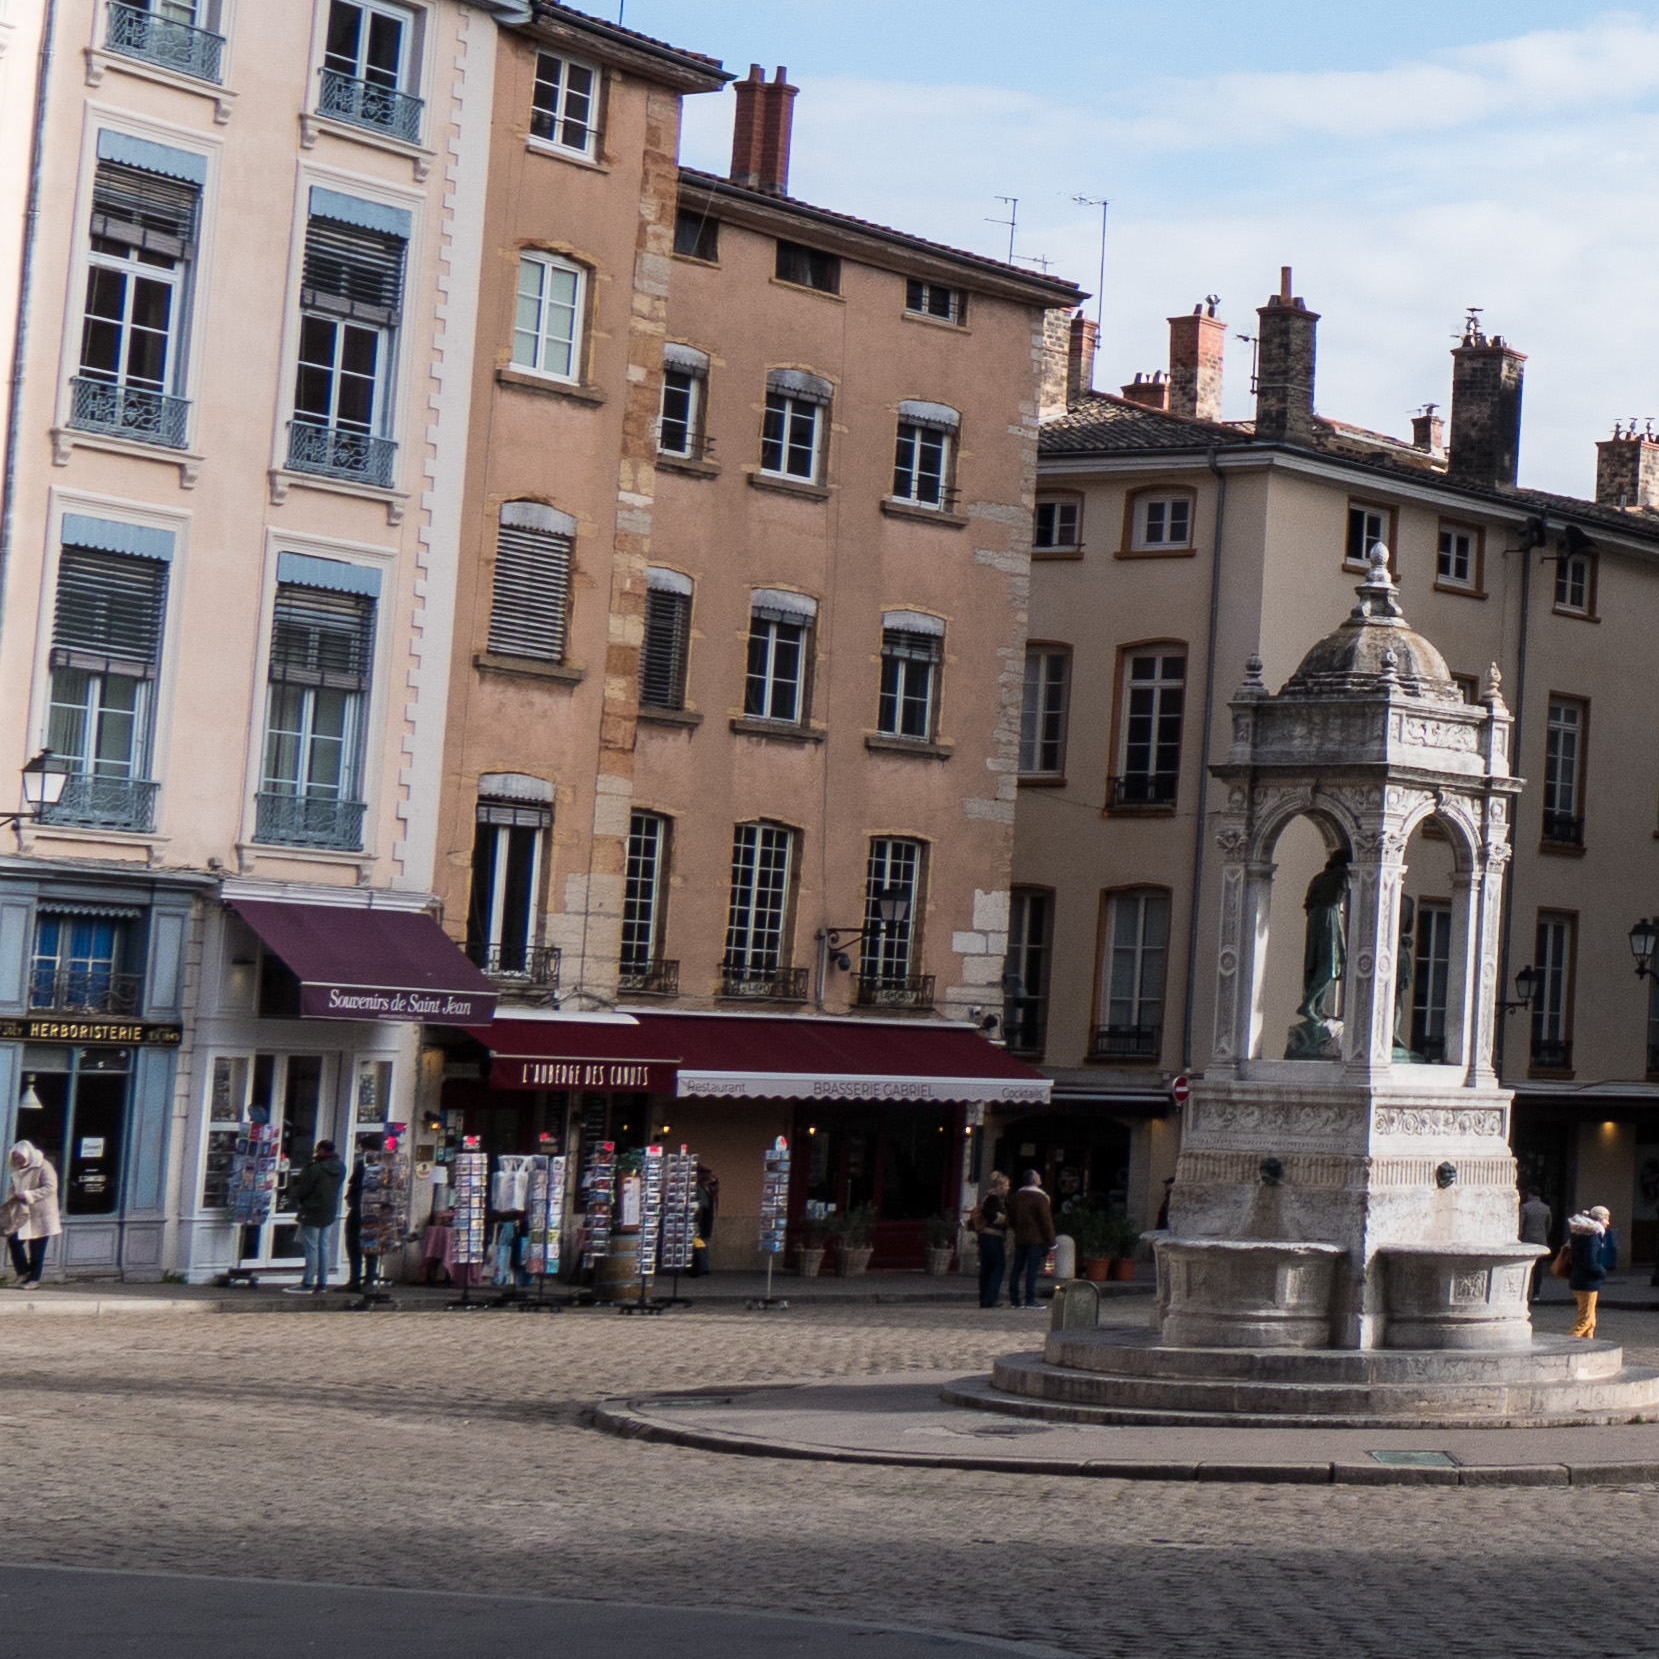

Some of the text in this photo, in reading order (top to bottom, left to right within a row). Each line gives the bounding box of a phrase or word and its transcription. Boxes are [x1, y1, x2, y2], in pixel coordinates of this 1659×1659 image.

[329, 989, 471, 1015] Souvenirs de Saint Jean
[30, 1023, 143, 1040] HERBORISTERIE
[522, 1063, 649, 1086] L'AUBERGE DES CANUTS
[687, 1079, 746, 1093] Restaurant
[813, 1081, 934, 1098] BRASSERIE GABRIEL
[1002, 1087, 1043, 1099] Cocktails
